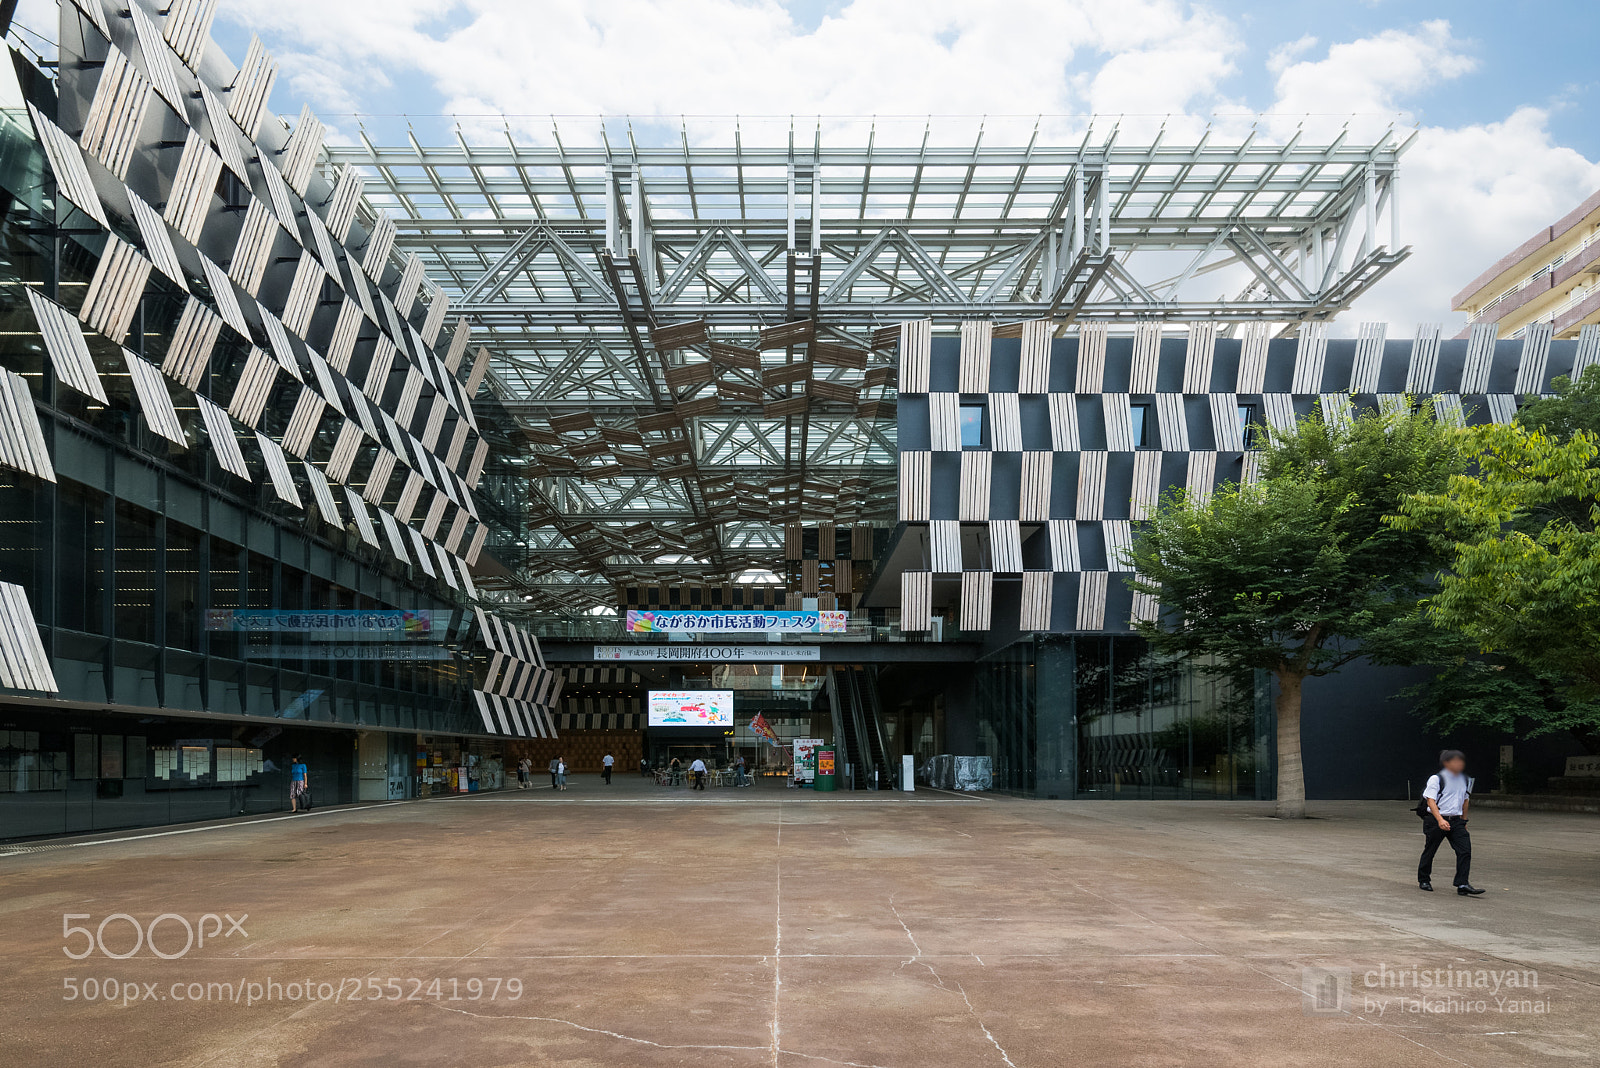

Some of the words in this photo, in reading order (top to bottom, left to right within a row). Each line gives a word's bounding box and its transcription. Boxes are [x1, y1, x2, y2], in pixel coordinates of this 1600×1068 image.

[655, 614, 817, 629] ながおか市民活動フェスタ
[656, 647, 745, 659] 長岡開府400年
